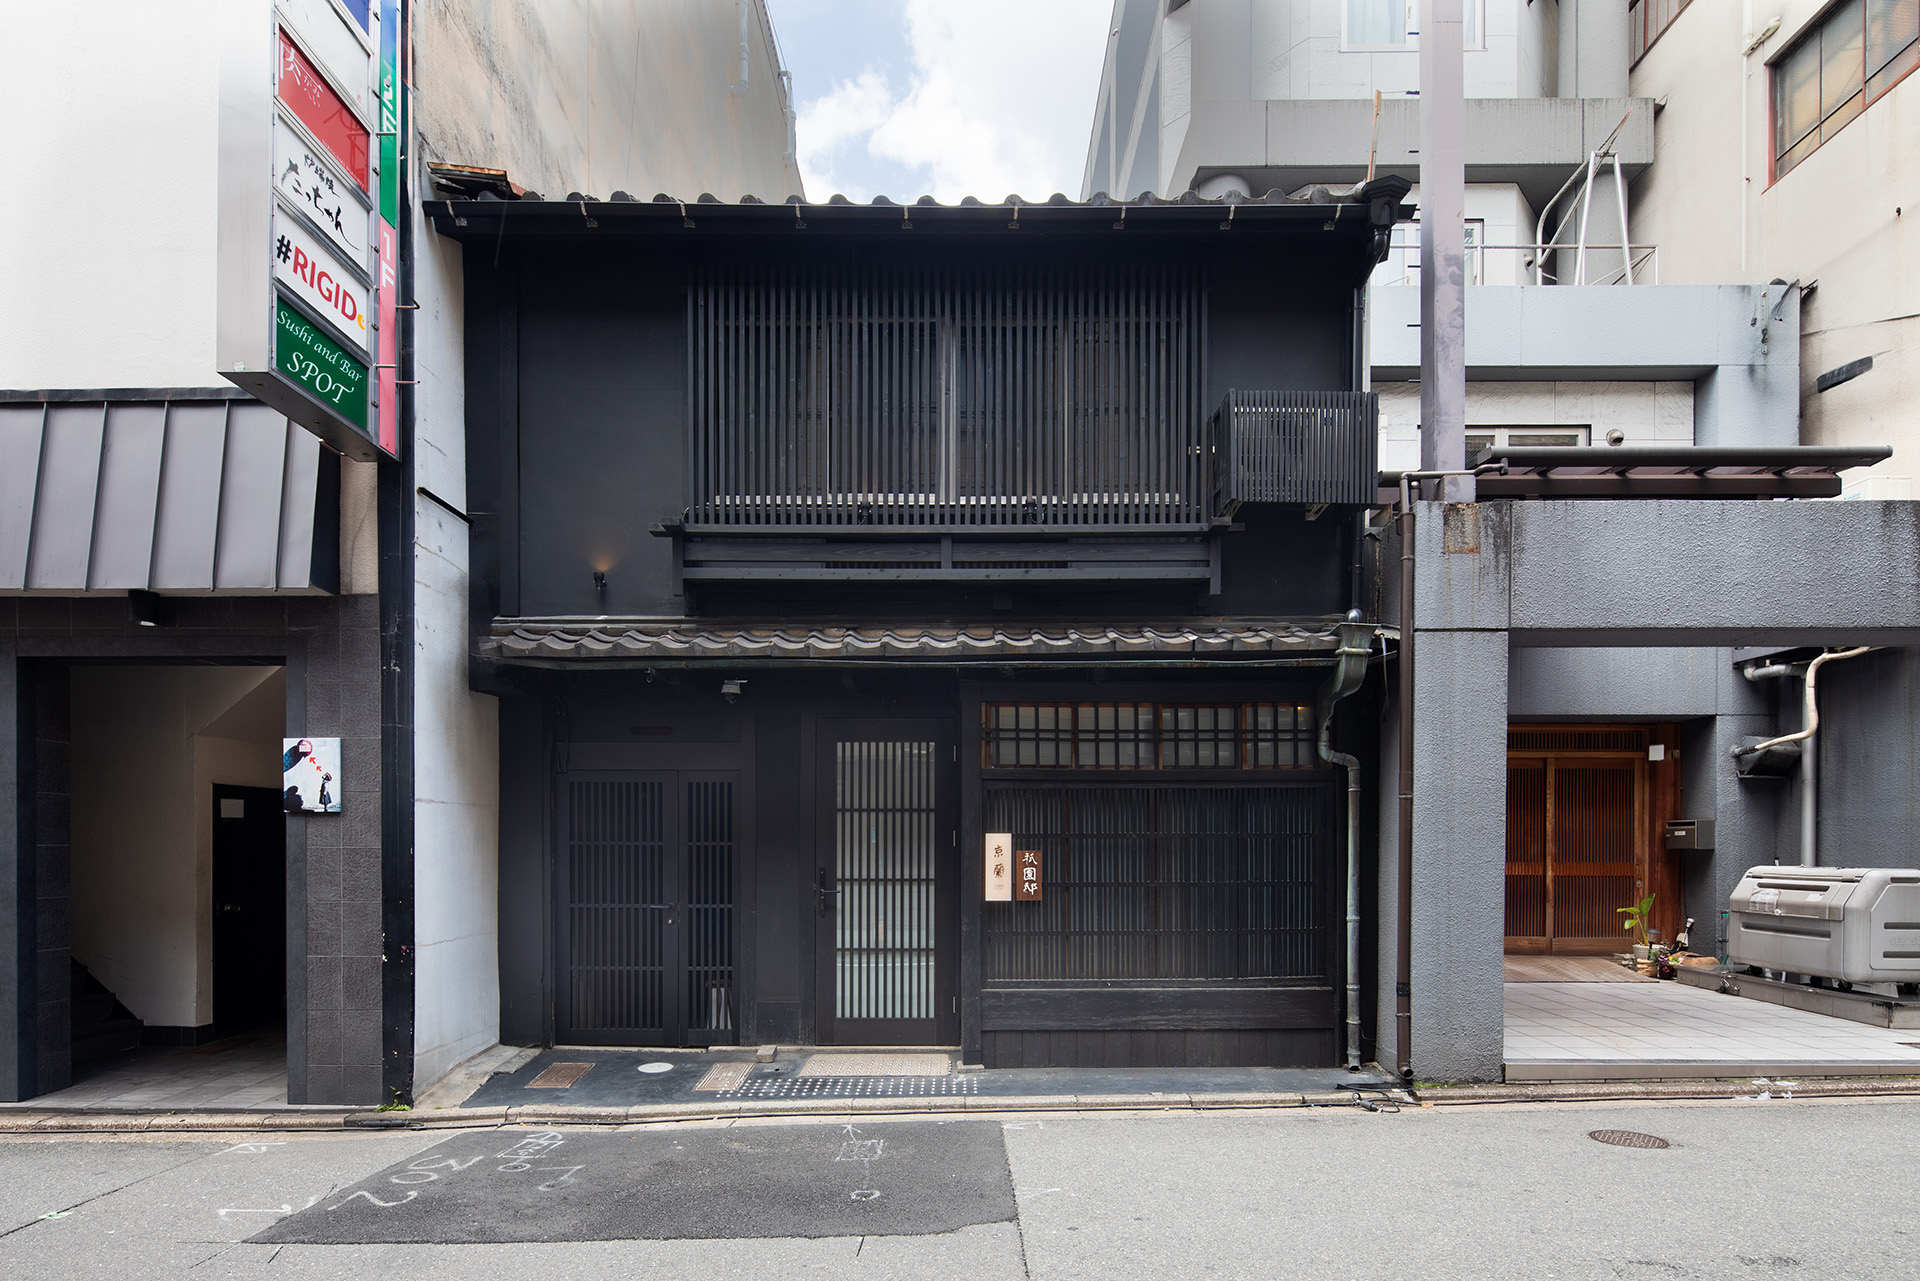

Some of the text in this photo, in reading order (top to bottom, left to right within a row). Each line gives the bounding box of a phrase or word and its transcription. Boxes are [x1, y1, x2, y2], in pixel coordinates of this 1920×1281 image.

[382, 231, 395, 288] 1F
[277, 311, 362, 381] Sushi and Bar
[287, 352, 355, 403] SPOT
